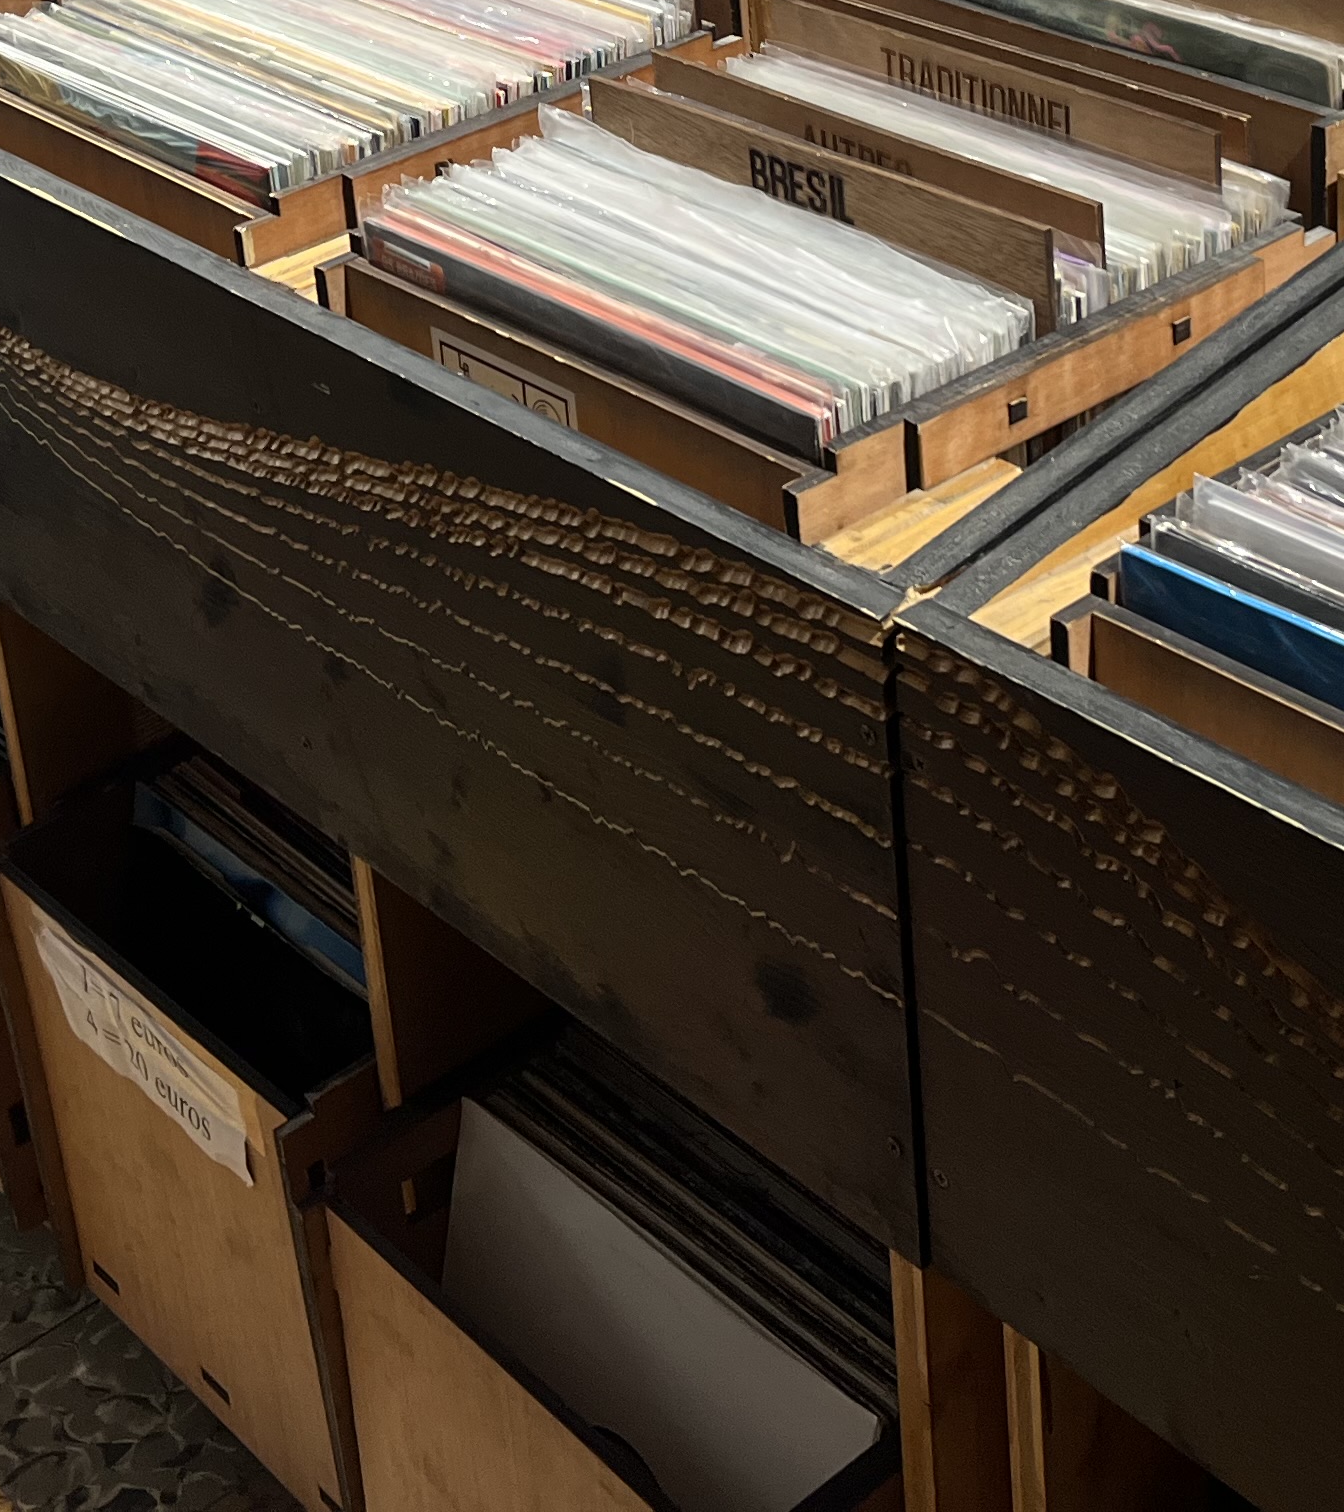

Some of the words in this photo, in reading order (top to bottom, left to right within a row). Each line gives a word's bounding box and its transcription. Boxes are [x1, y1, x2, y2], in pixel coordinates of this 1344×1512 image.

[749, 147, 855, 226] BRESIL
[130, 1015, 190, 1079] euros
[123, 1038, 149, 1082] 20
[154, 1075, 212, 1141] euros
